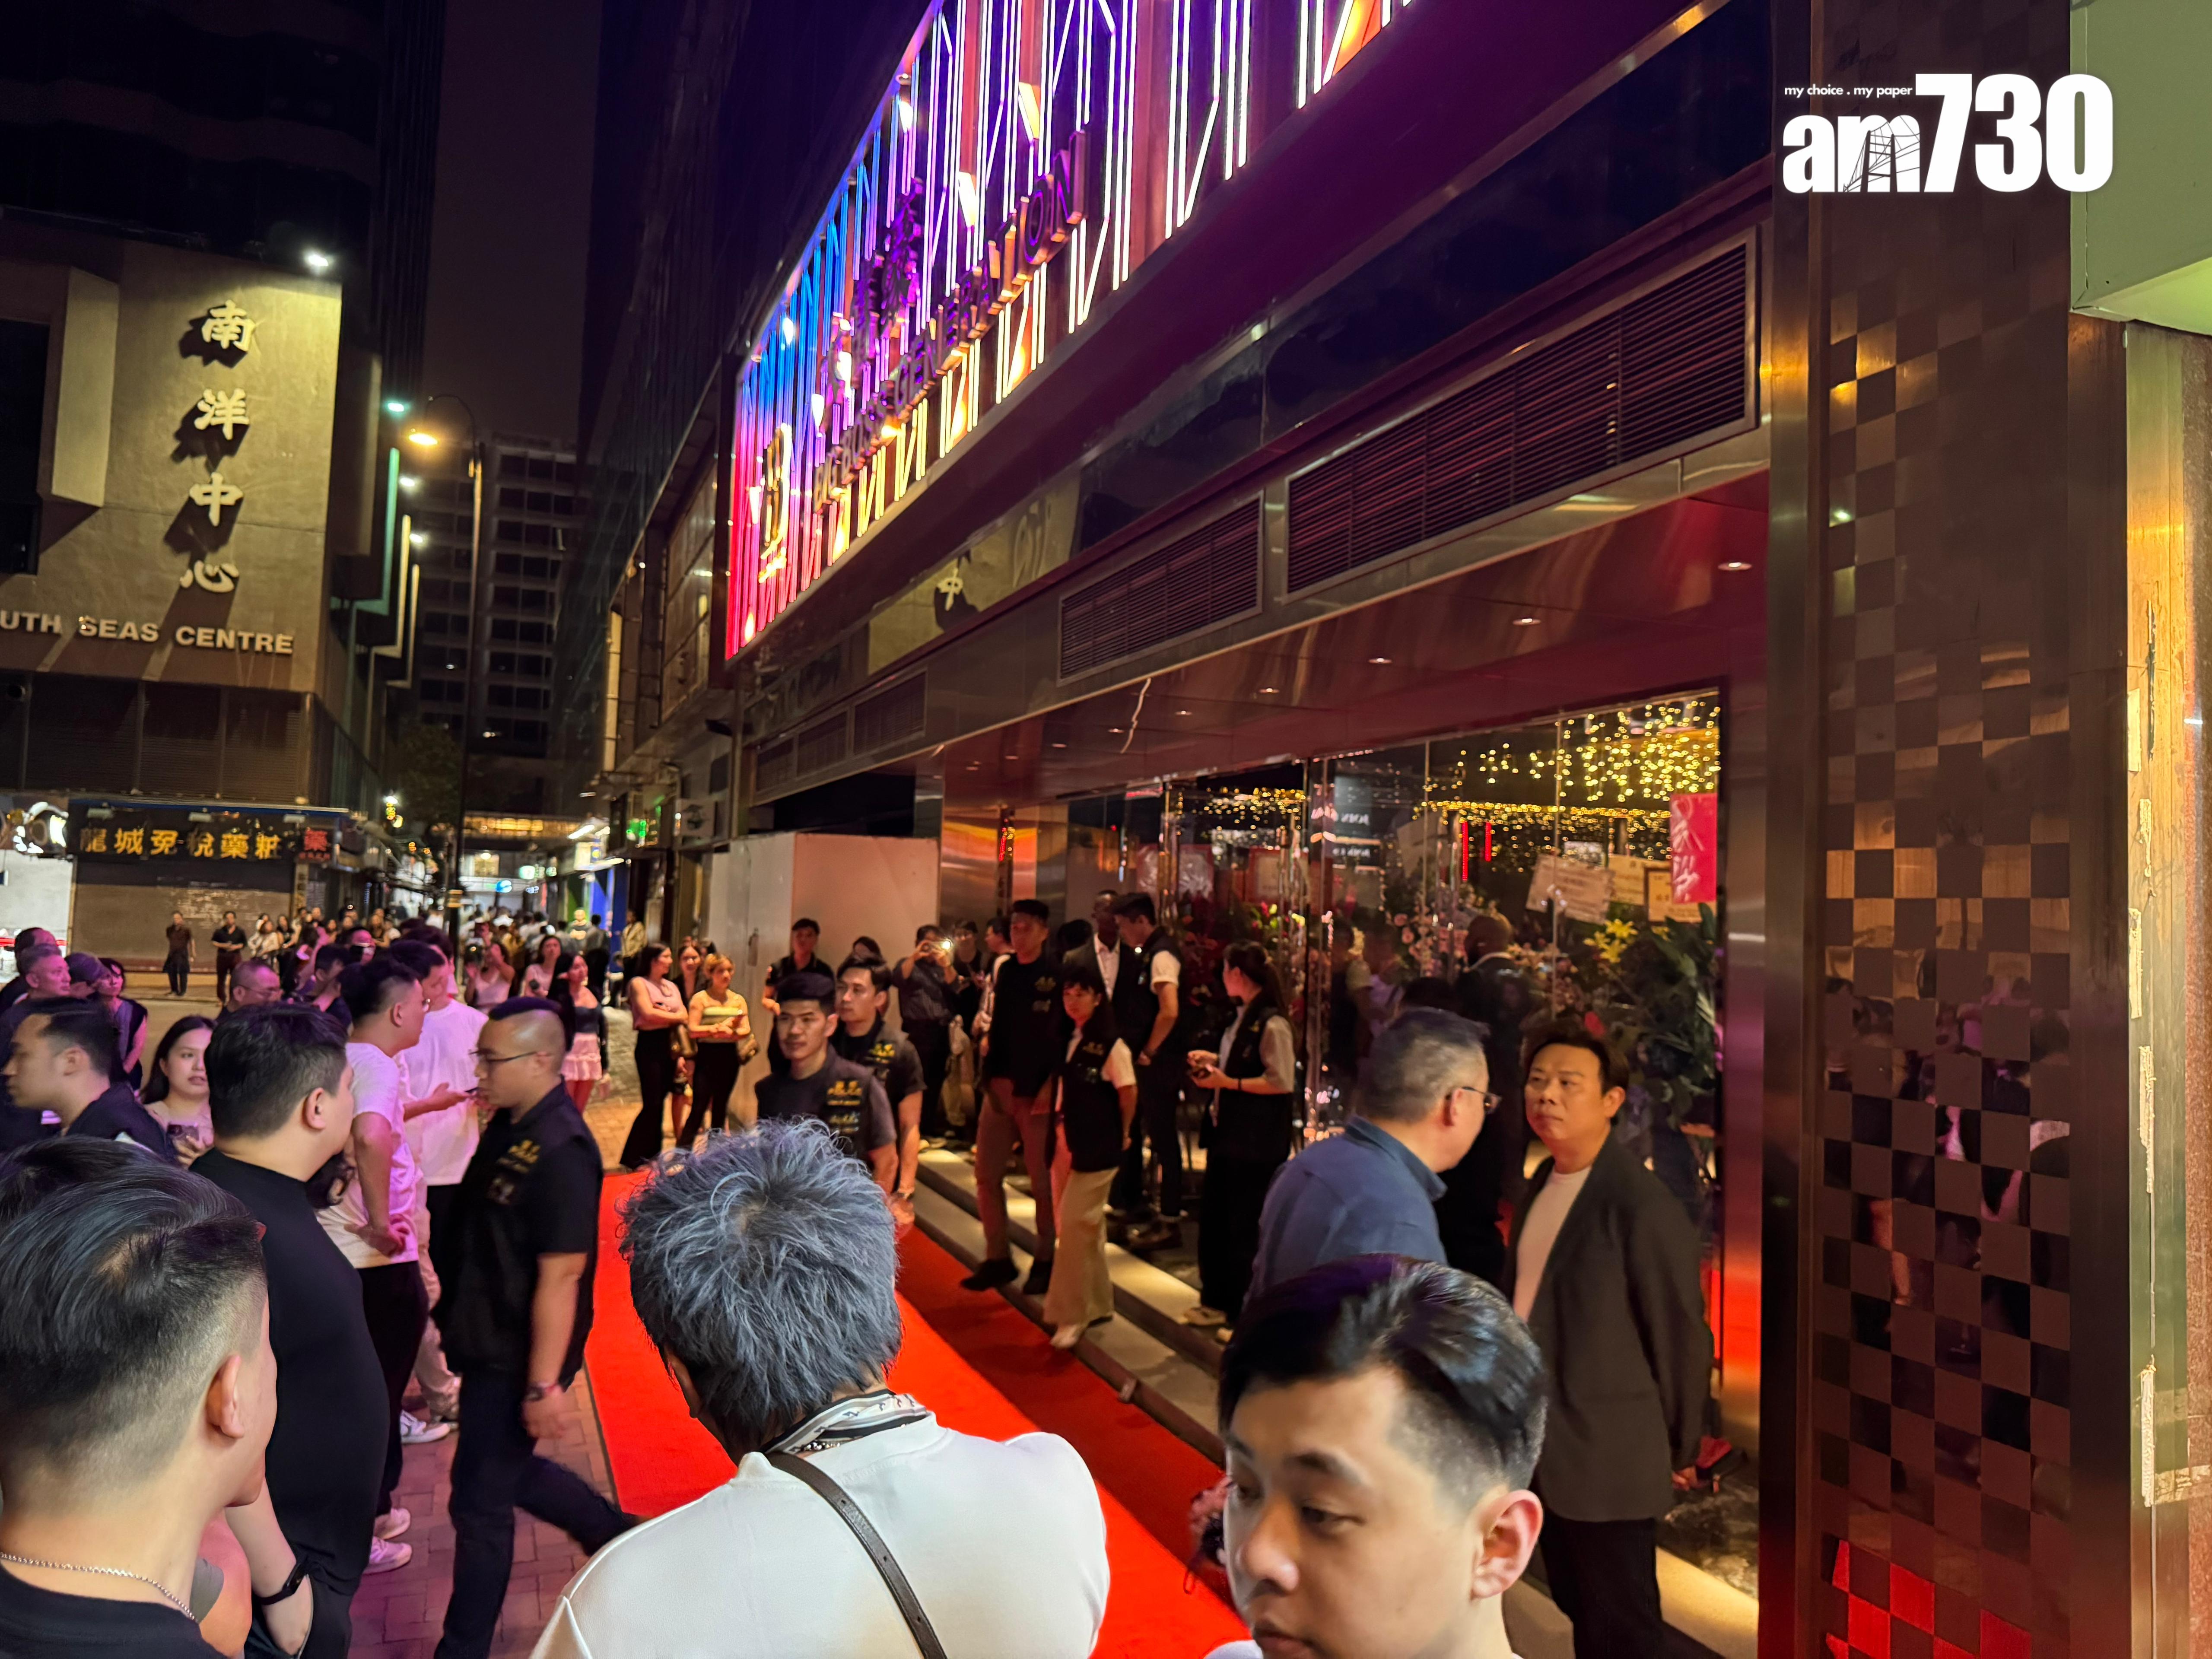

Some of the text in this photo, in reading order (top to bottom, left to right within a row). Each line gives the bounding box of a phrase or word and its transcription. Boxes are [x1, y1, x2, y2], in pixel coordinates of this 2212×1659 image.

[894, 130, 1087, 419] GENERATION
[180, 299, 256, 594] 南洋中心
[79, 615, 160, 642] SEAS
[176, 625, 295, 655] CENTRE
